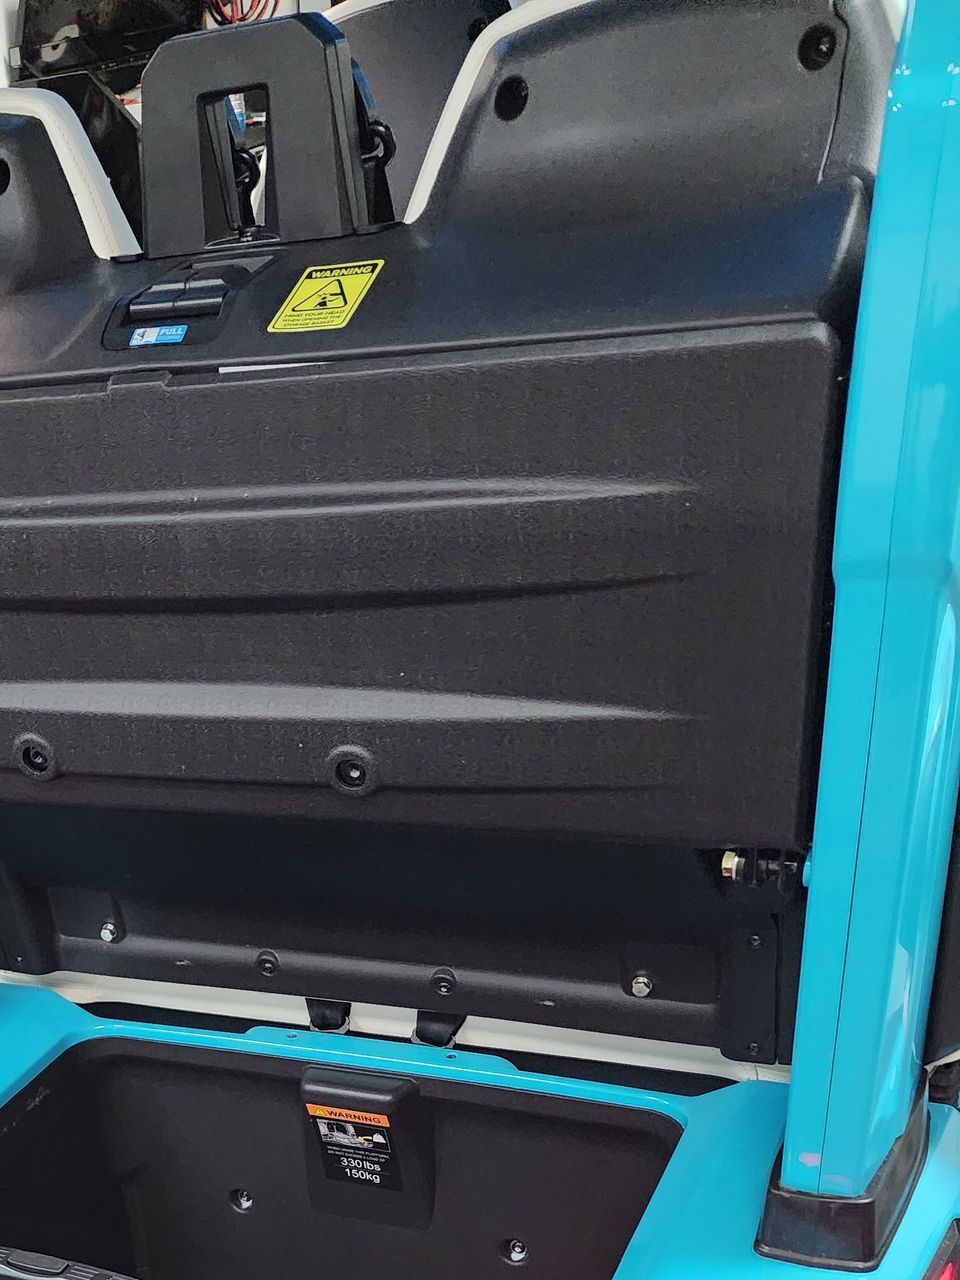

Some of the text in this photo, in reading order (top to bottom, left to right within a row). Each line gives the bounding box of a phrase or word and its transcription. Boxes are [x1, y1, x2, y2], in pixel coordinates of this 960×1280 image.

[311, 265, 373, 279] WARNING
[159, 327, 183, 336] PULL
[327, 1109, 381, 1124] WARNING
[344, 1168, 381, 1184] 150kg
